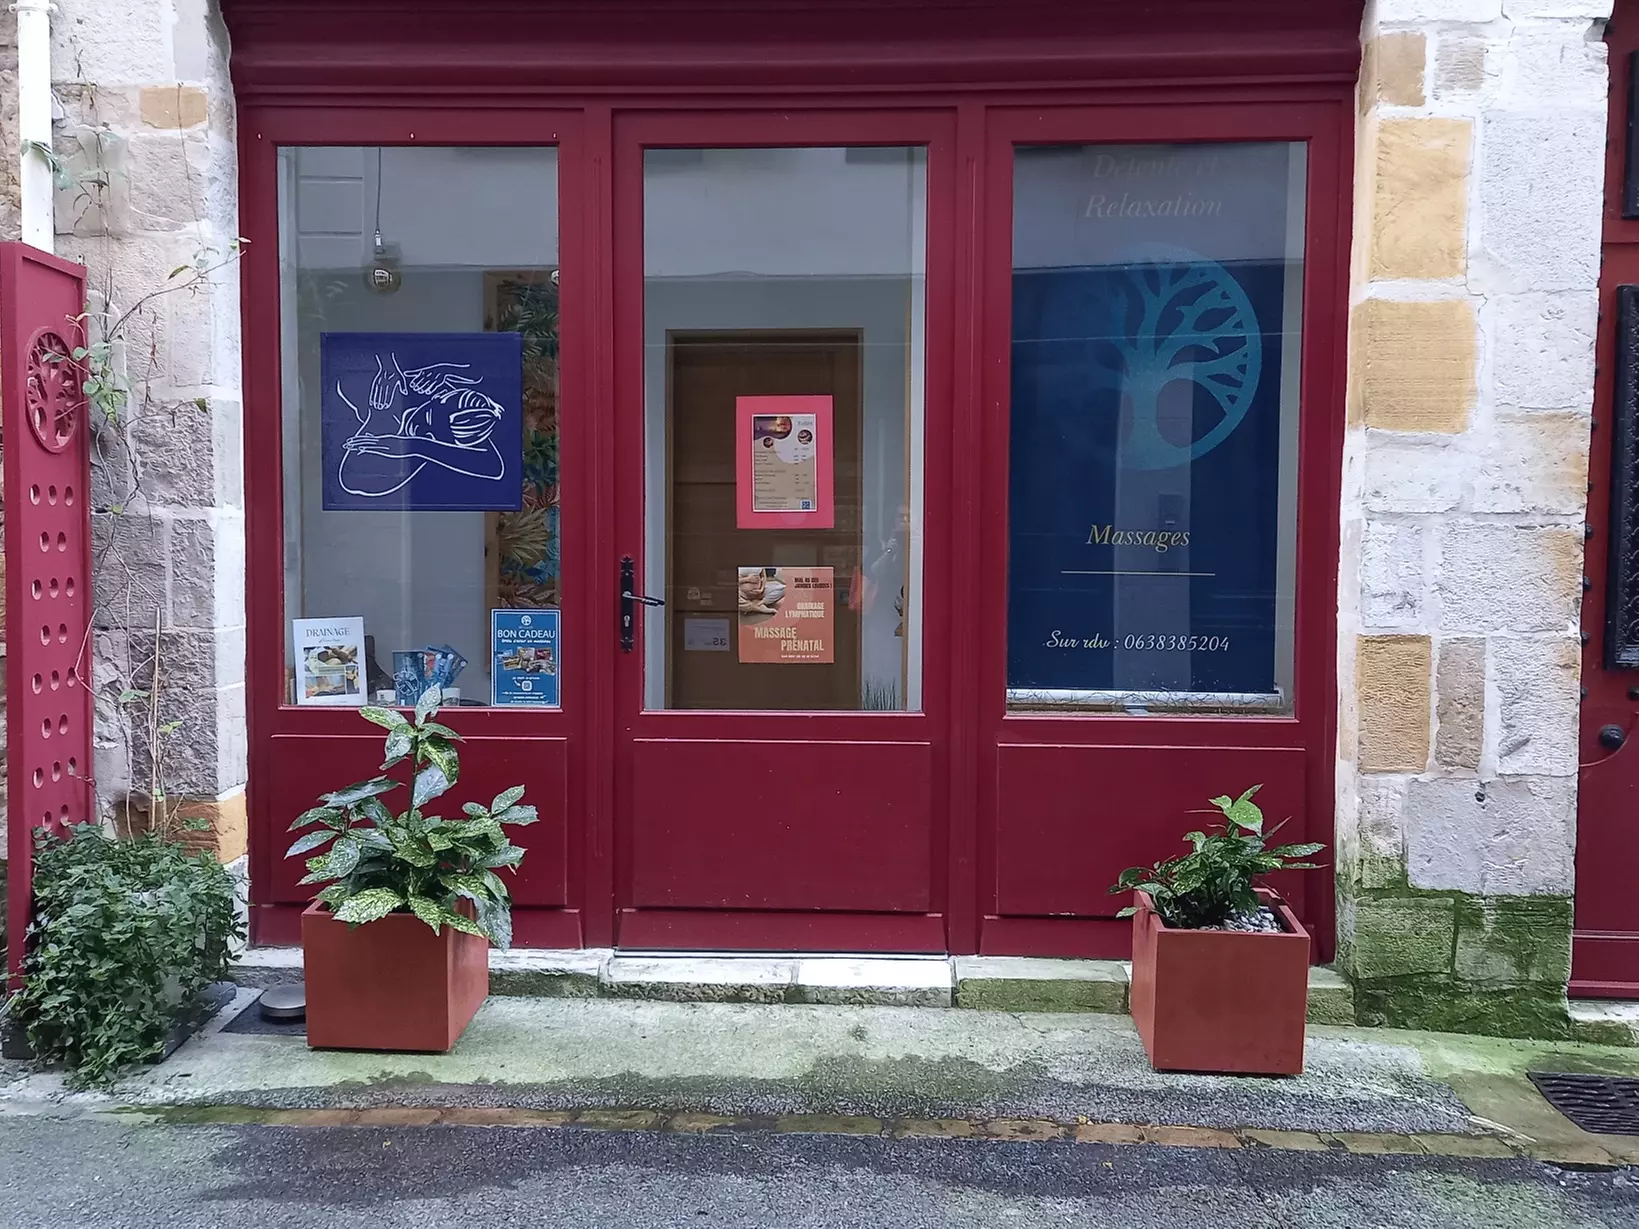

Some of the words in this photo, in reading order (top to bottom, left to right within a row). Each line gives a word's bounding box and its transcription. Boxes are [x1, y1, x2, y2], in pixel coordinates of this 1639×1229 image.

[1084, 192, 1223, 218] Relaxation
[1086, 524, 1191, 553] Massages
[305, 626, 351, 637] DRAINAGE
[497, 629, 517, 638] BON
[518, 629, 556, 639] CADEAU
[754, 627, 797, 639] MASSAGE
[1046, 629, 1080, 649] Sur
[1083, 632, 1111, 649] rdv
[1123, 633, 1230, 651] 0638385204
